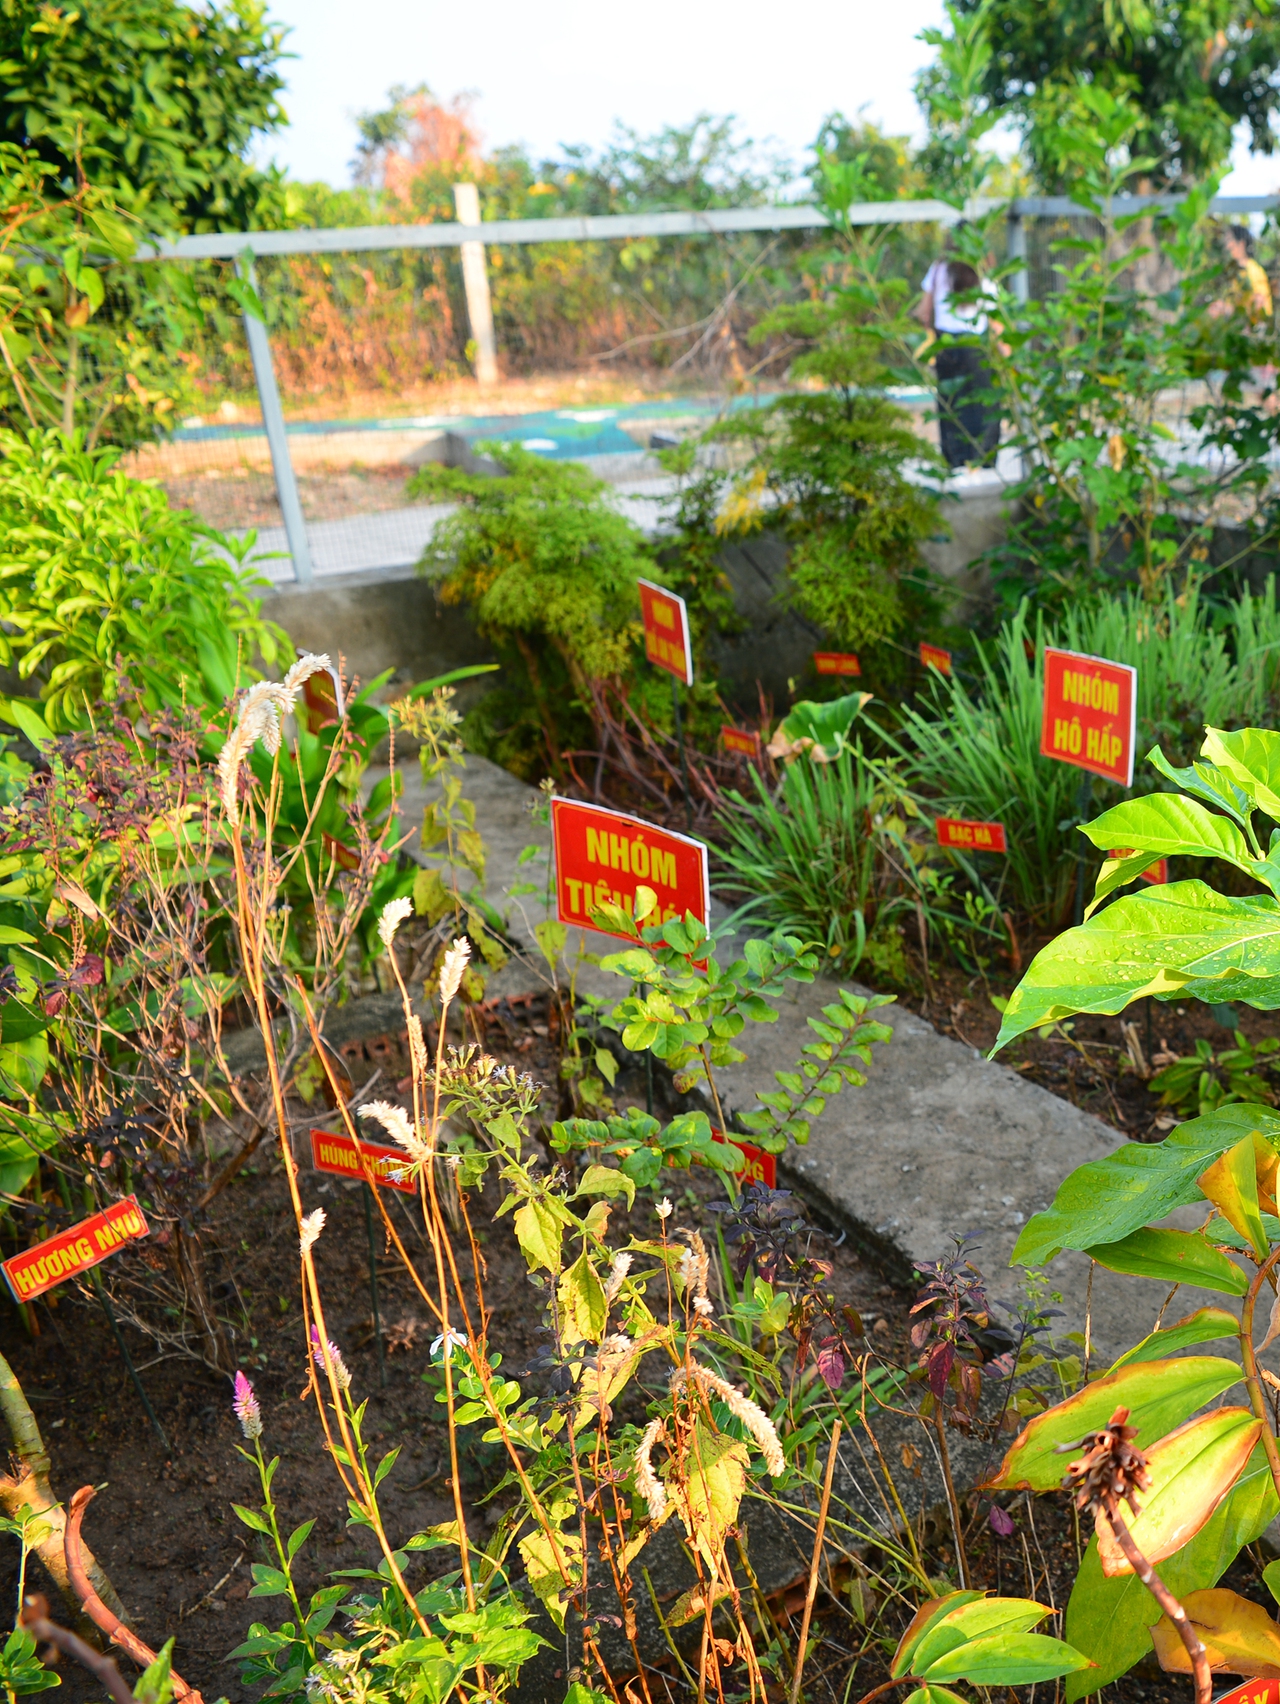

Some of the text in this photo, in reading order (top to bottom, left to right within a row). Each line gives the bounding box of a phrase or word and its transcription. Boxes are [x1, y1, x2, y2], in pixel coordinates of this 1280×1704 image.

[1063, 670, 1119, 716] NHÓM
[1053, 716, 1122, 768] HÔ HẤP
[585, 826, 677, 889] NHÓM
[14, 1210, 141, 1293] HƯƠNG NHU
